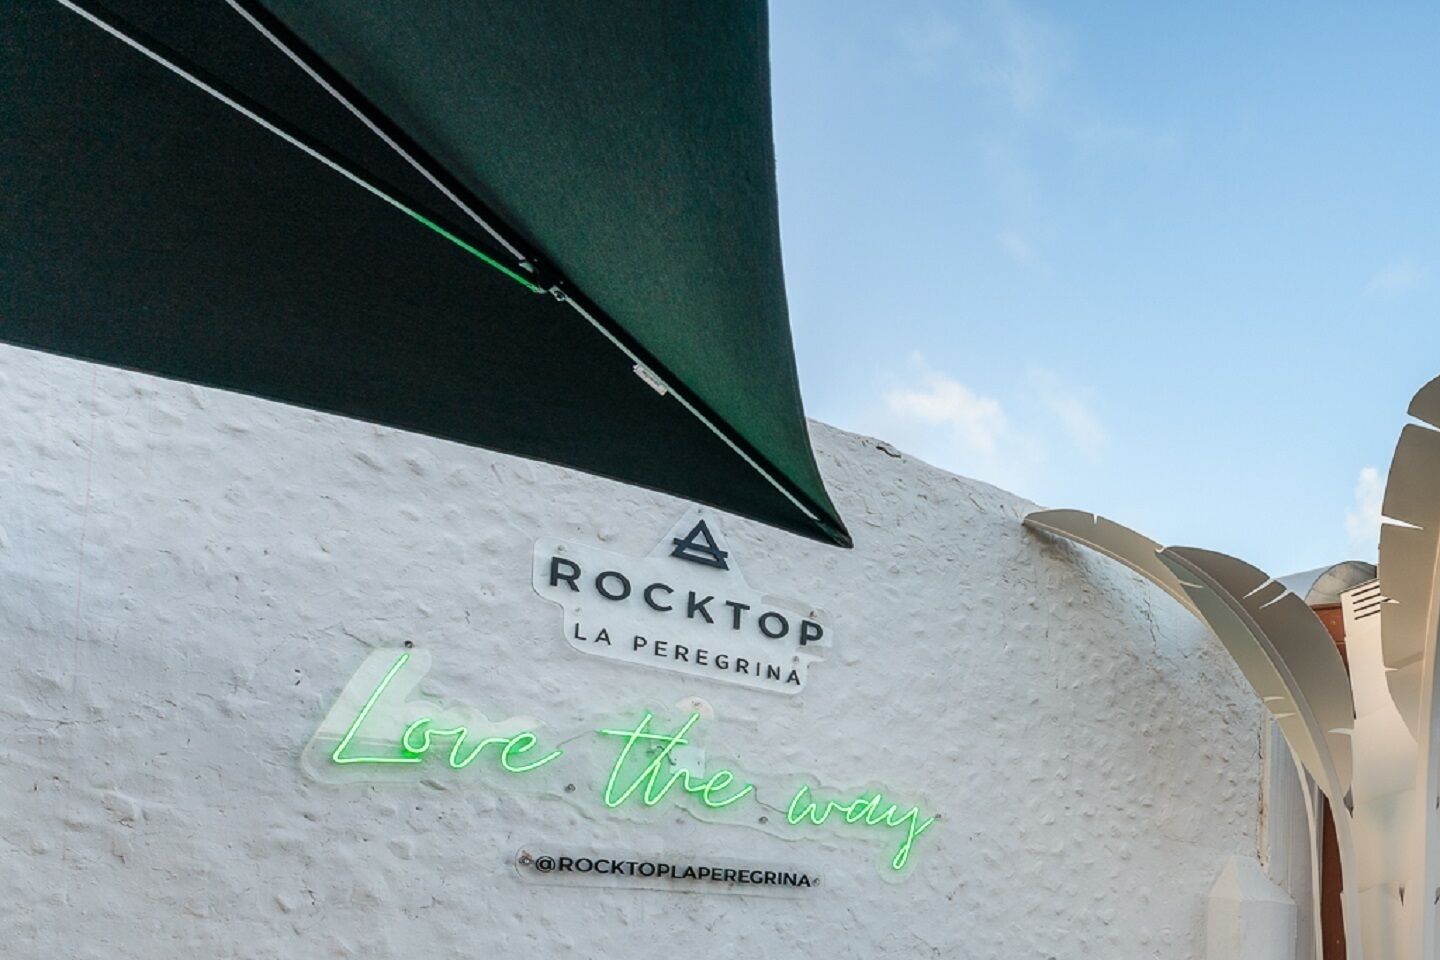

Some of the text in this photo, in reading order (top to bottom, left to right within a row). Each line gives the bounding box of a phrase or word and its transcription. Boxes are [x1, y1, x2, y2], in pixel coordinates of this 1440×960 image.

[549, 556, 824, 646] ROCKTOP
[574, 622, 801, 686] LA PEREGRINA
[331, 652, 934, 871] Love the way
[535, 855, 812, 888] @ROCKTOPLAPEREGRINA
